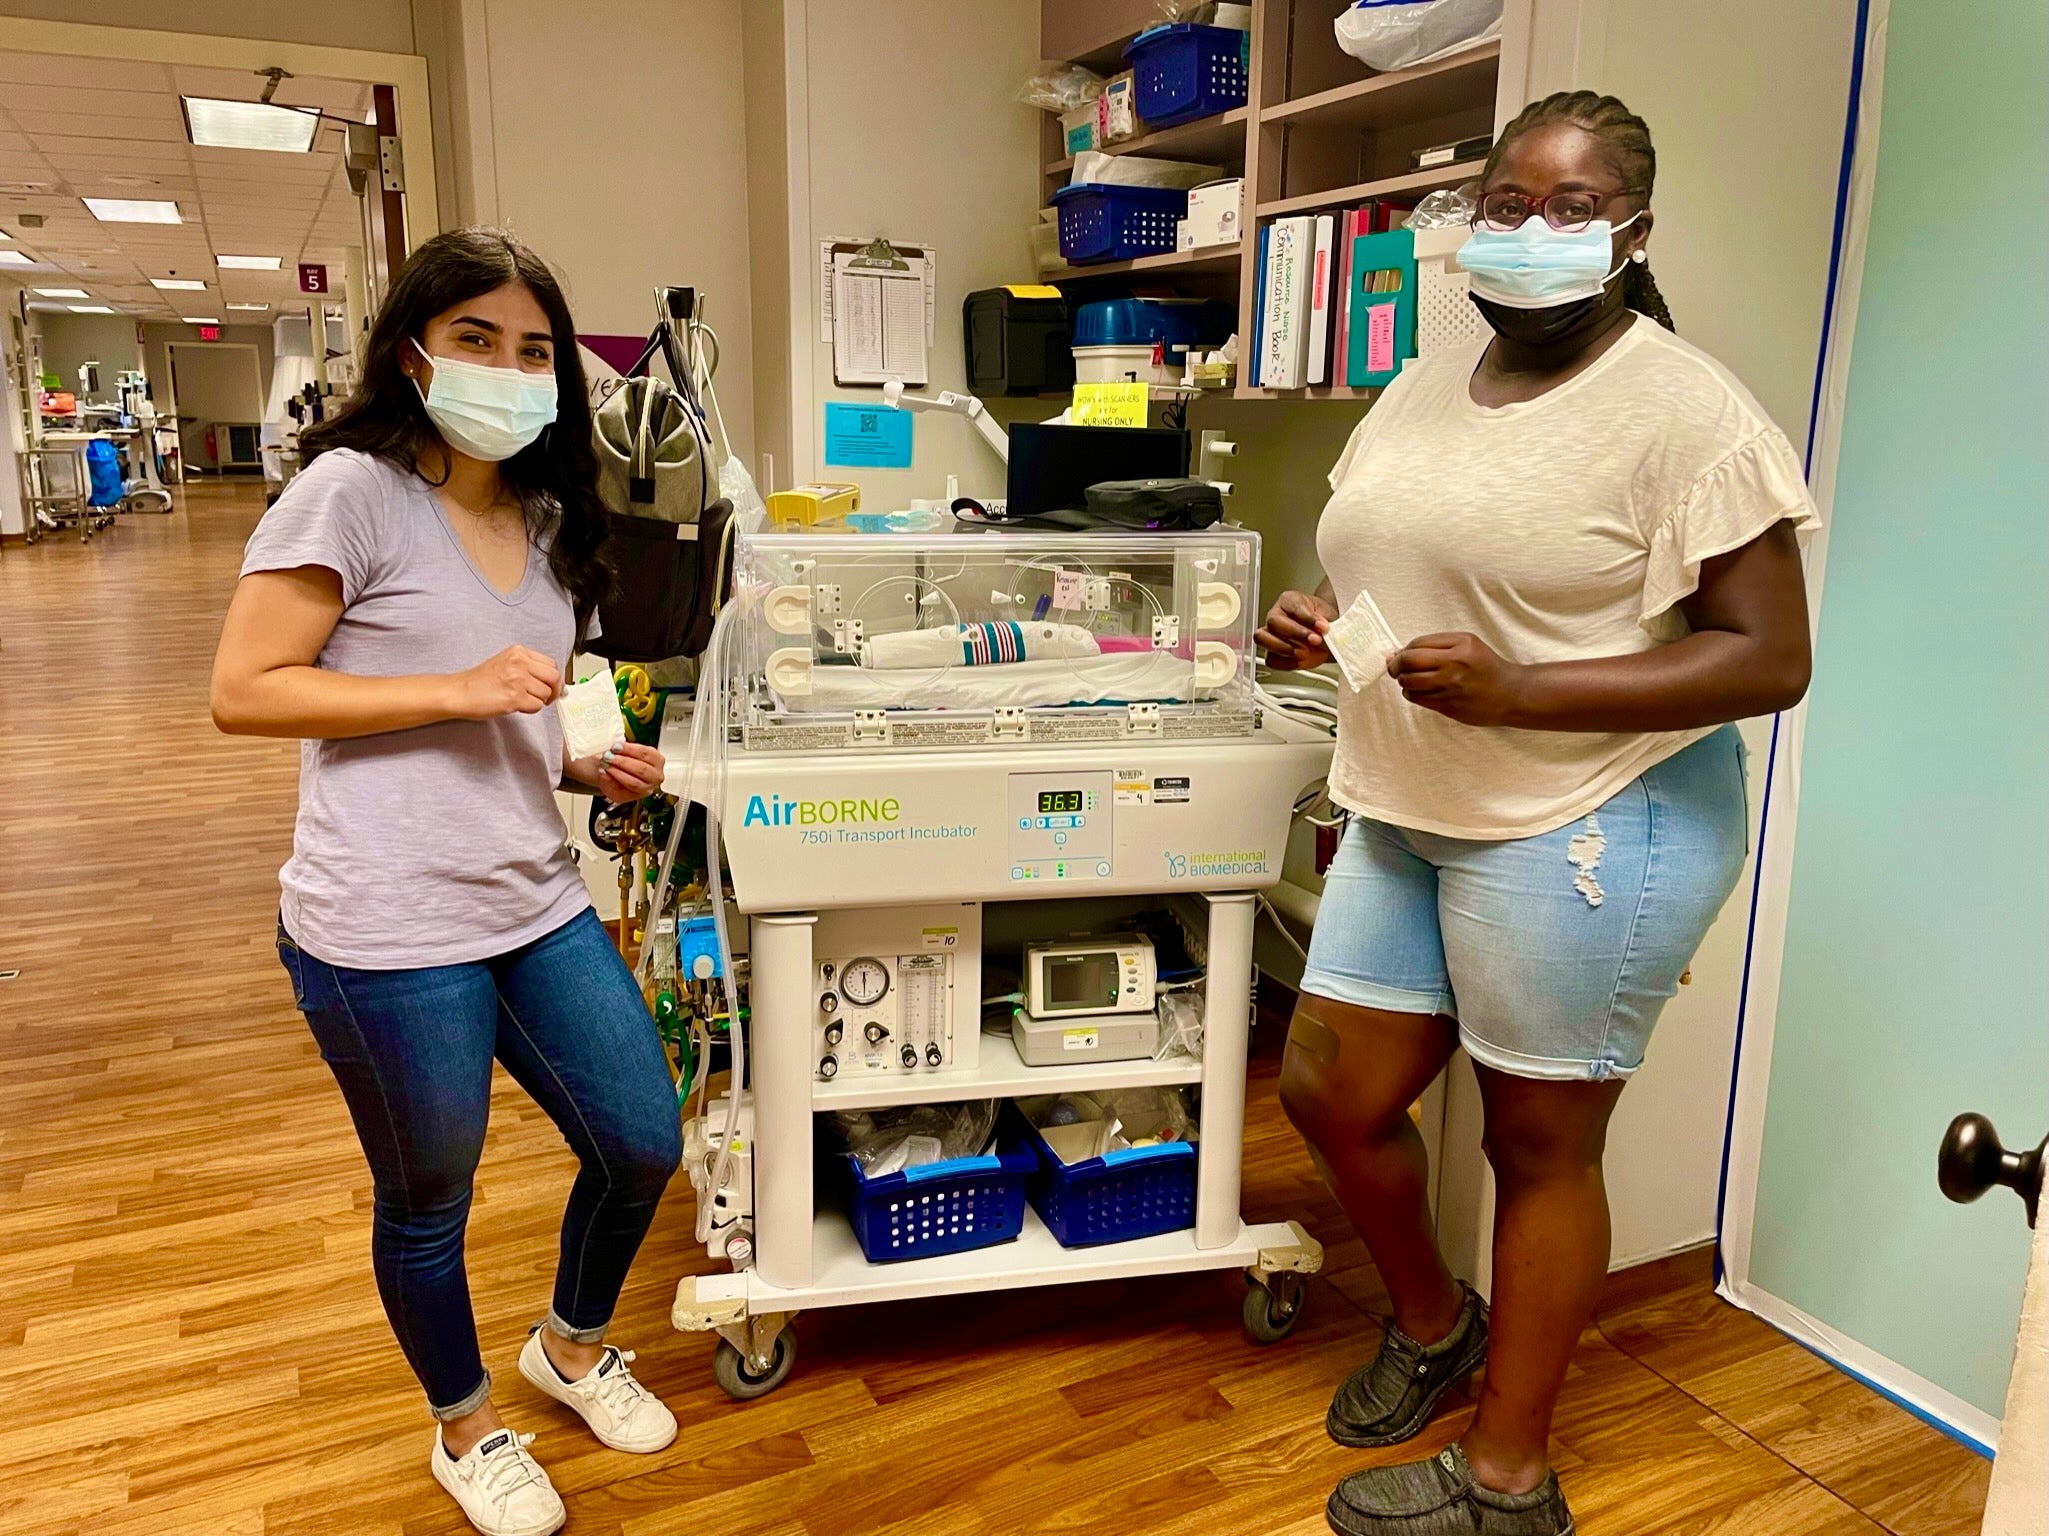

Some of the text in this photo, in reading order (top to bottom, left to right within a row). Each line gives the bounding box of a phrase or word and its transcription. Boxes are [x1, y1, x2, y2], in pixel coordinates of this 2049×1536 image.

[308, 275, 319, 290] 5
[1272, 227, 1288, 323] Communication
[1282, 257, 1294, 342] Resource Nurse
[1082, 416, 1133, 426] NURSING ONLY
[1042, 794, 1079, 811] 36.3
[800, 825, 978, 844] 750i Transport Incubator
[1190, 849, 1266, 863] international
[944, 936, 956, 946] 10
